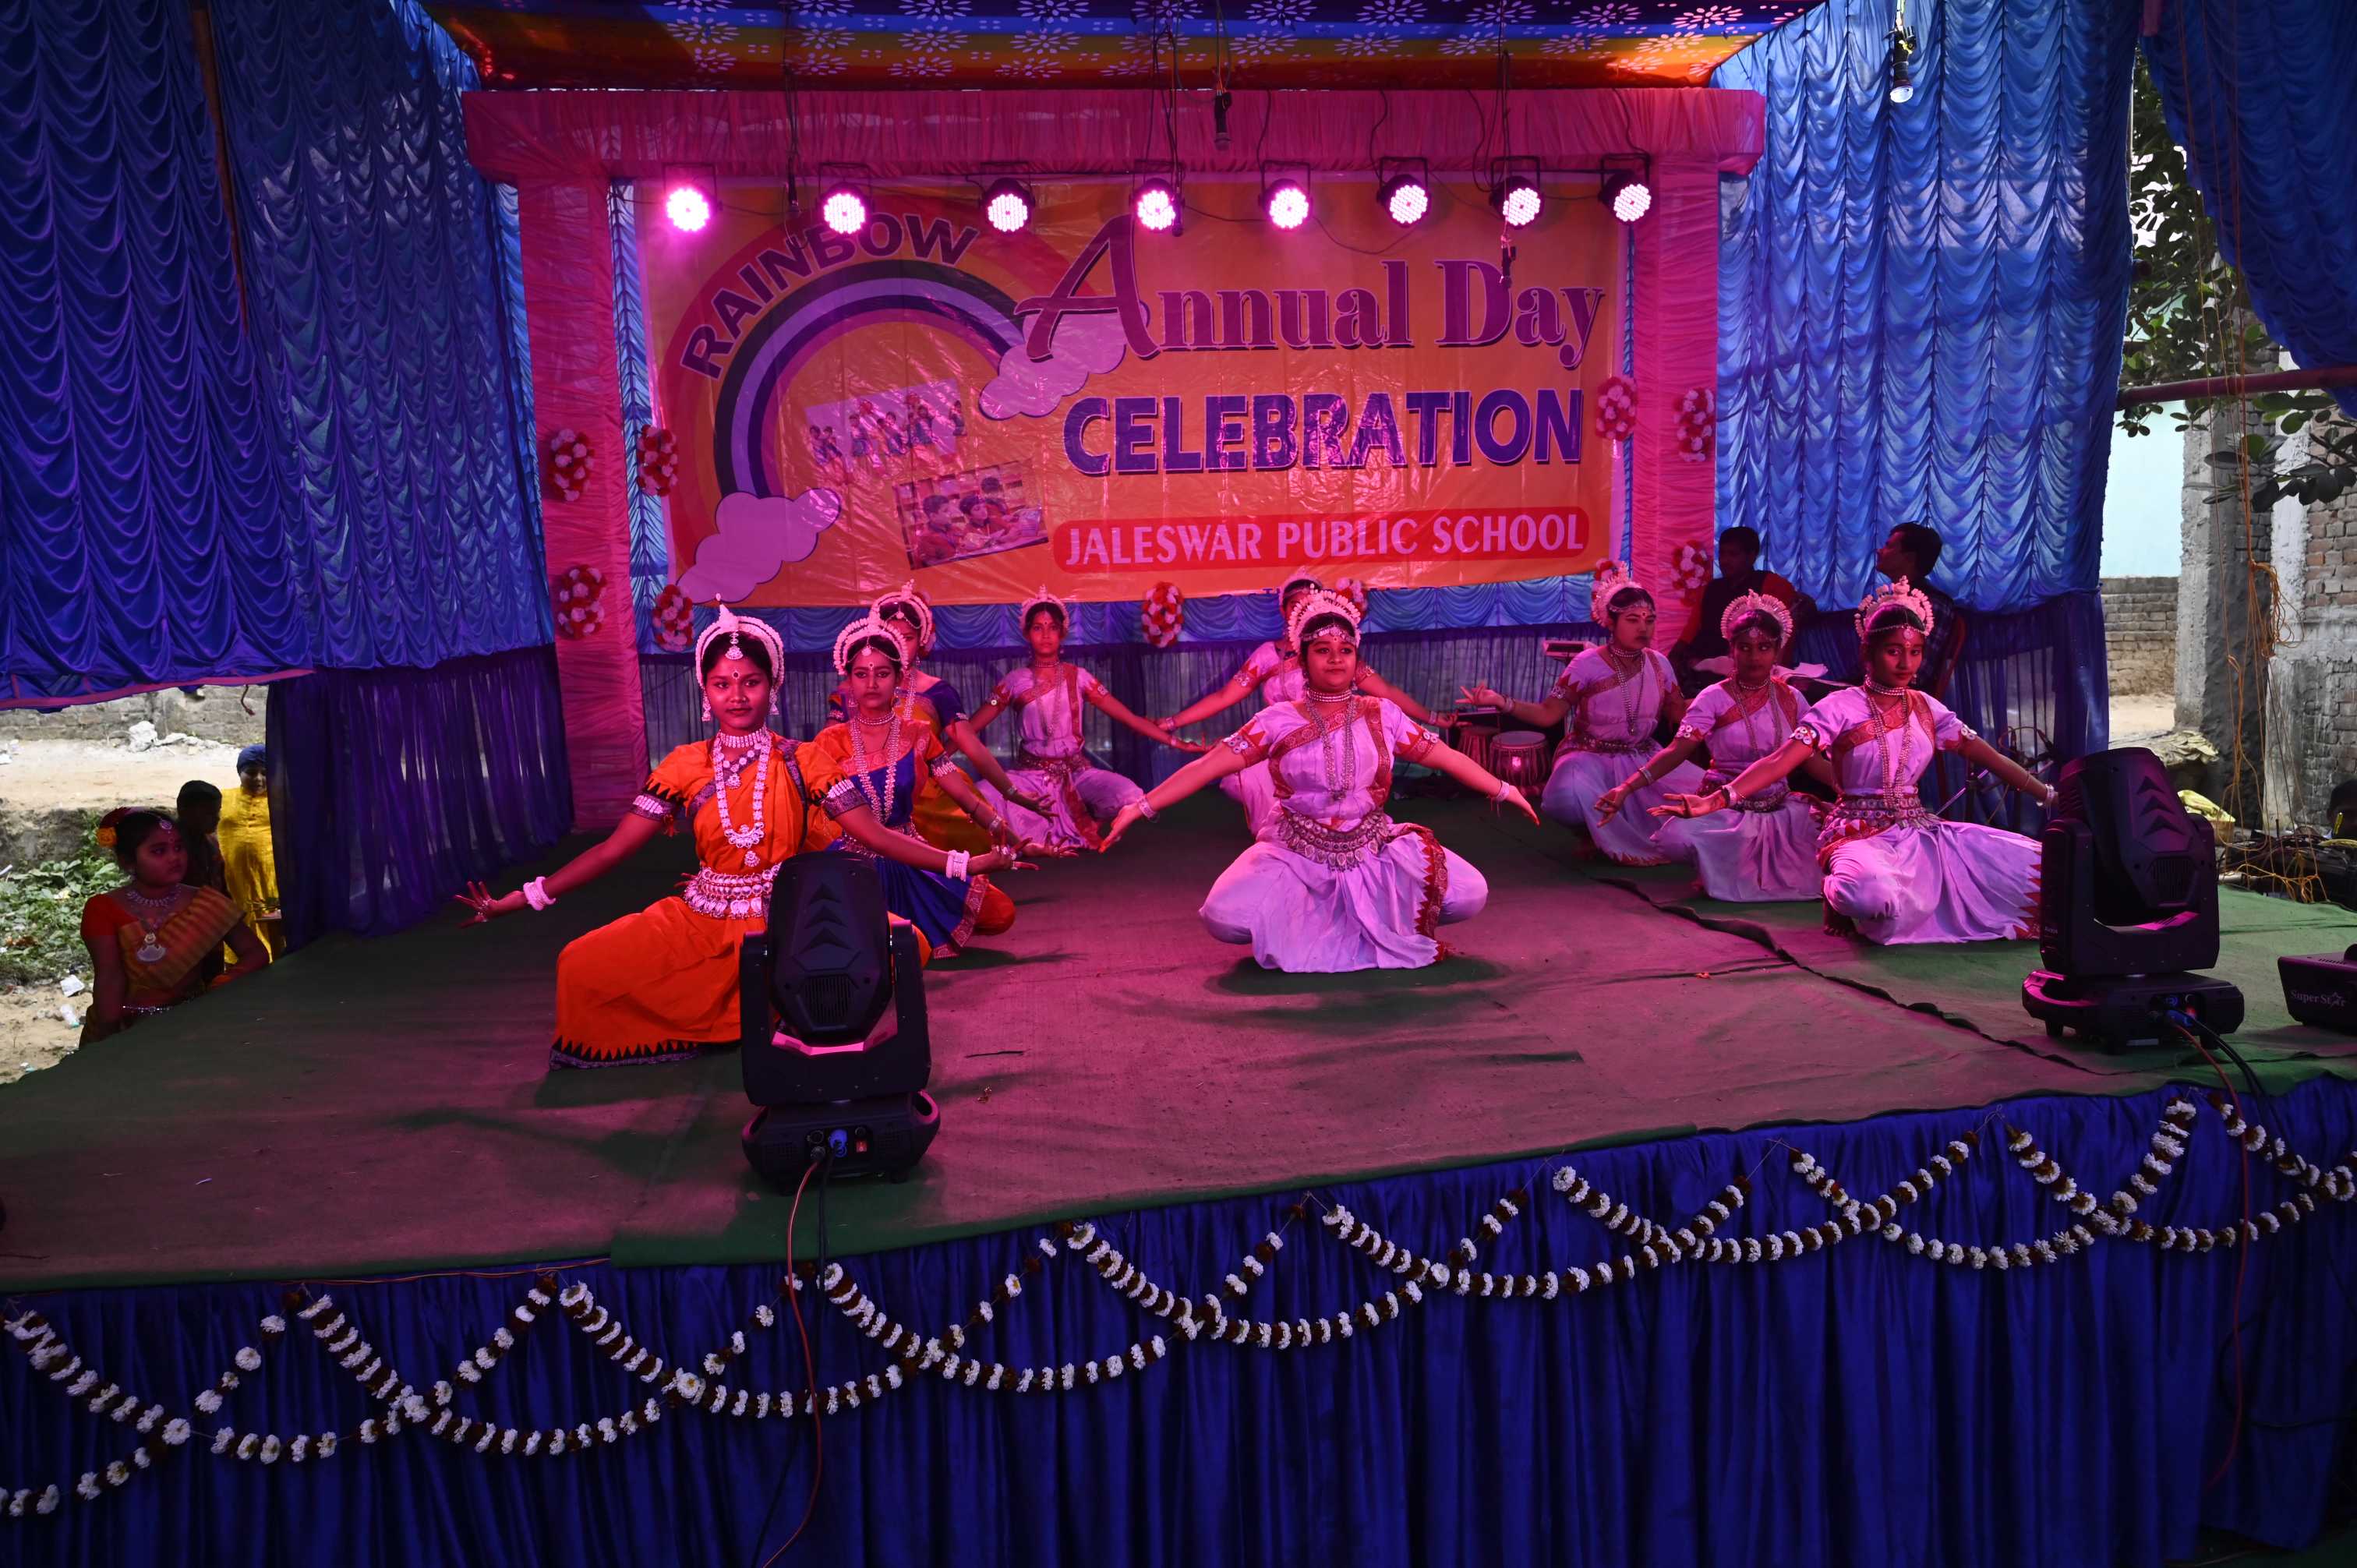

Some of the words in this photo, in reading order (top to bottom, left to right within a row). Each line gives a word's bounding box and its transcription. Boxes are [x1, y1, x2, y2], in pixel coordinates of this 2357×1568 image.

[680, 211, 980, 380] RAINBOW
[1014, 214, 1414, 362] Annual
[1434, 259, 1606, 370] Day
[1063, 389, 1584, 477] CELEBRATION
[1065, 521, 1262, 567] JALESWAR
[1277, 518, 1418, 560] PUBLIC
[1433, 514, 1584, 556] SCHOOL
